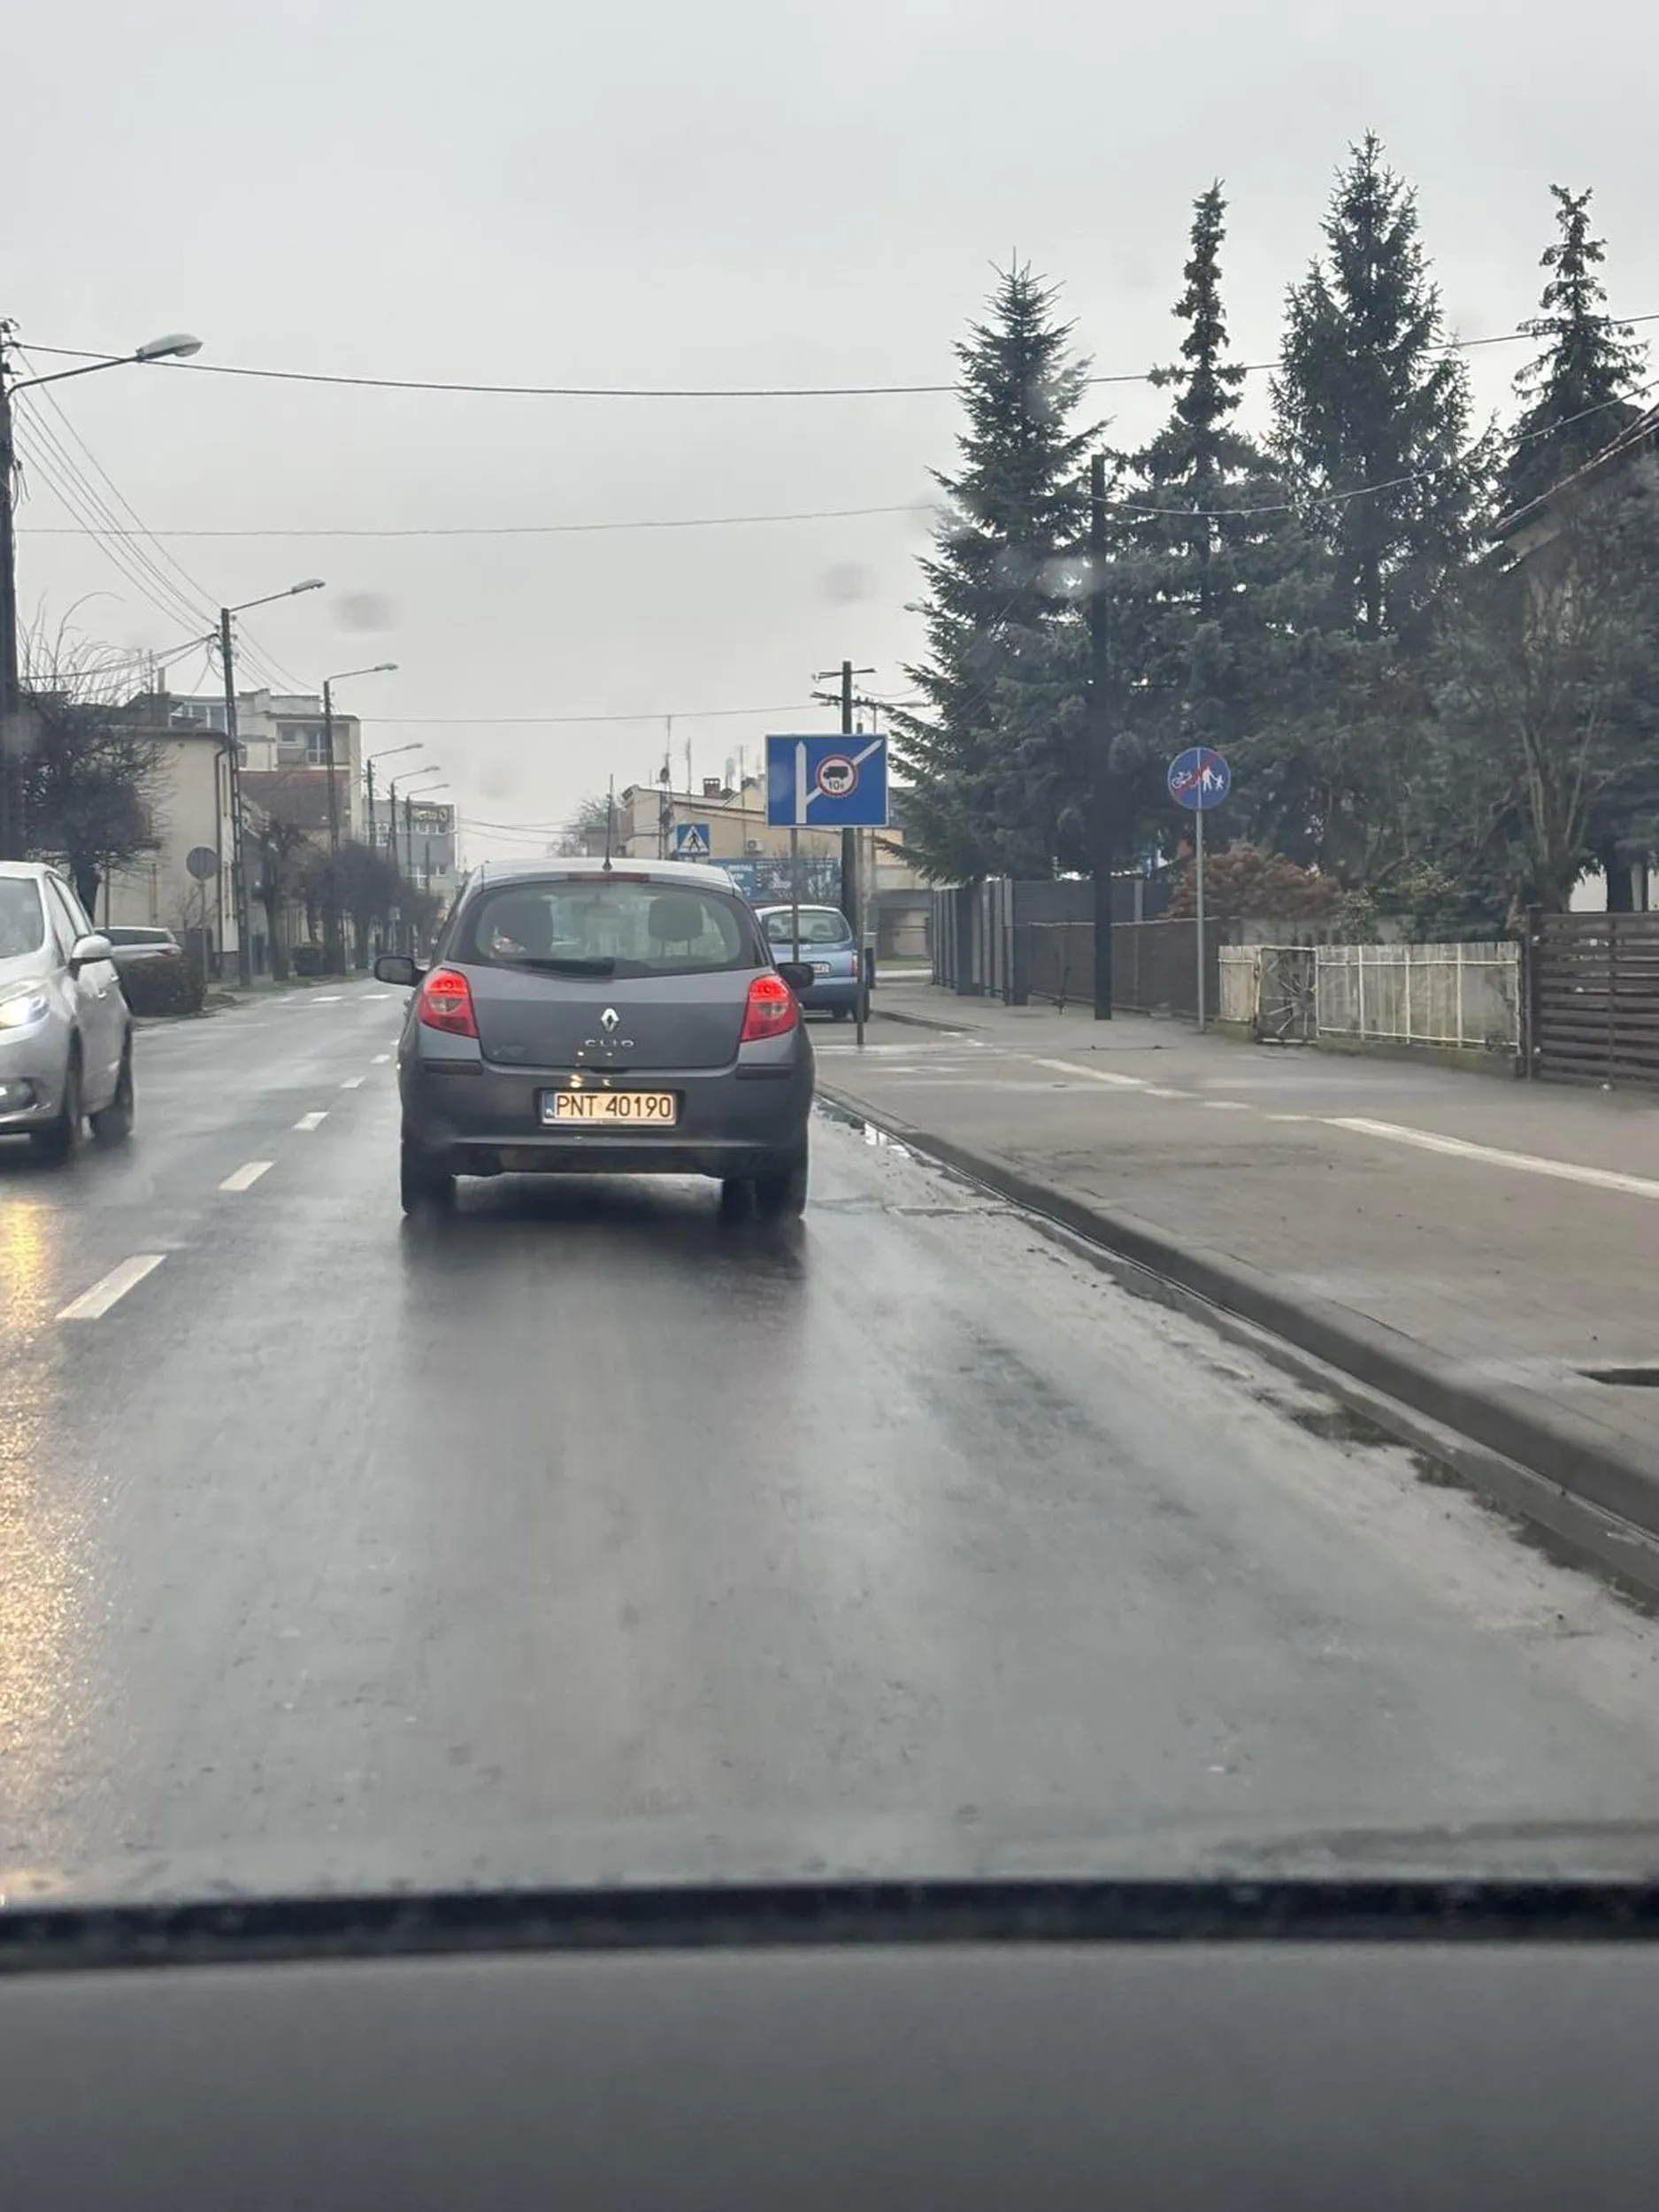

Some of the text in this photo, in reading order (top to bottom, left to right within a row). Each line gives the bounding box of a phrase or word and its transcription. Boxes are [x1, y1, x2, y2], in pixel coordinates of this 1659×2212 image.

[585, 1039, 634, 1048] CLIO
[557, 1095, 671, 1118] PNT 40190
